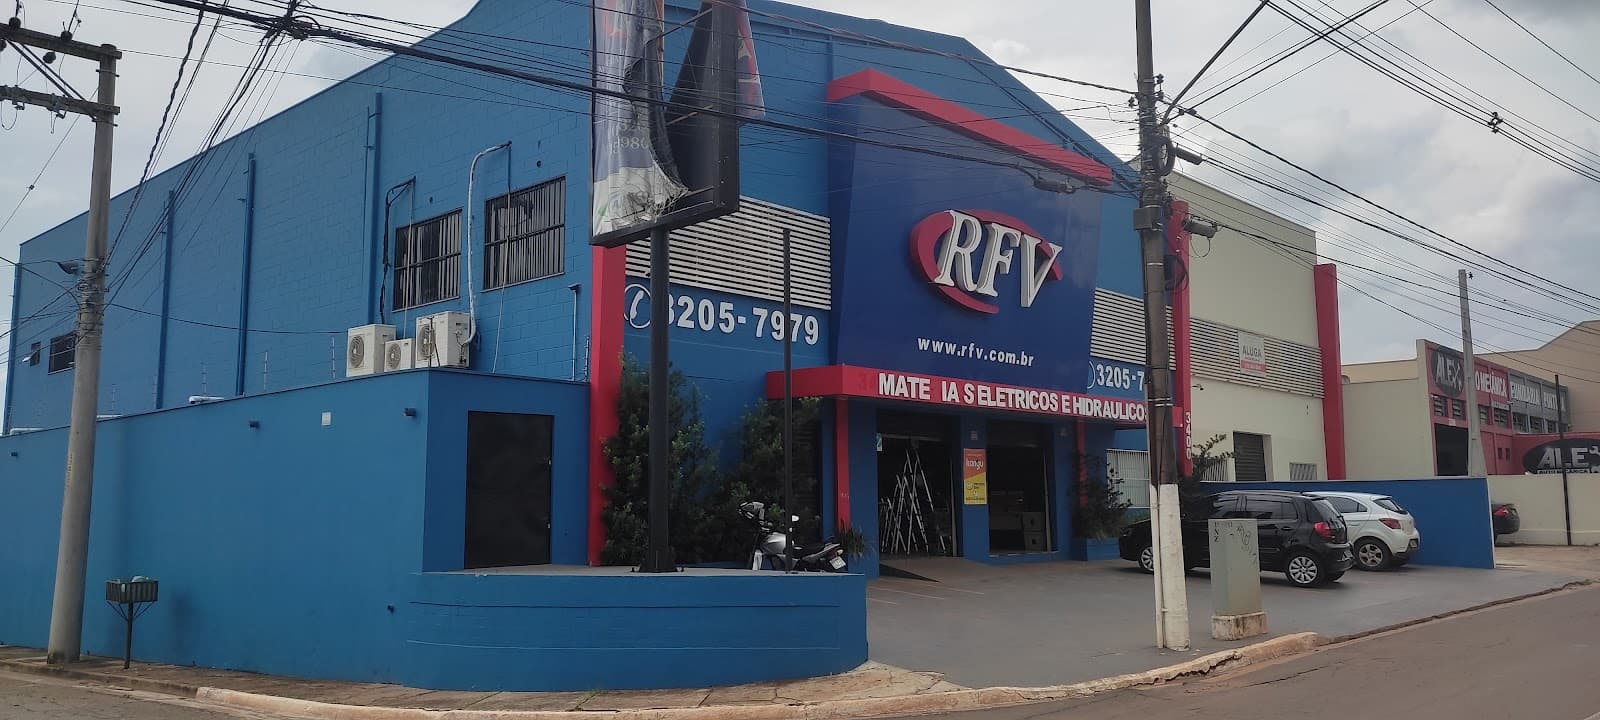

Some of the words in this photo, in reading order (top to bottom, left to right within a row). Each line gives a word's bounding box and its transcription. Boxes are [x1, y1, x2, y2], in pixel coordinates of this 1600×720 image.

[928, 210, 1063, 307] RFV
[917, 337, 1035, 367] www.rfv.com.br
[977, 384, 1058, 412] ELETRICOS
[1062, 395, 1071, 413] E
